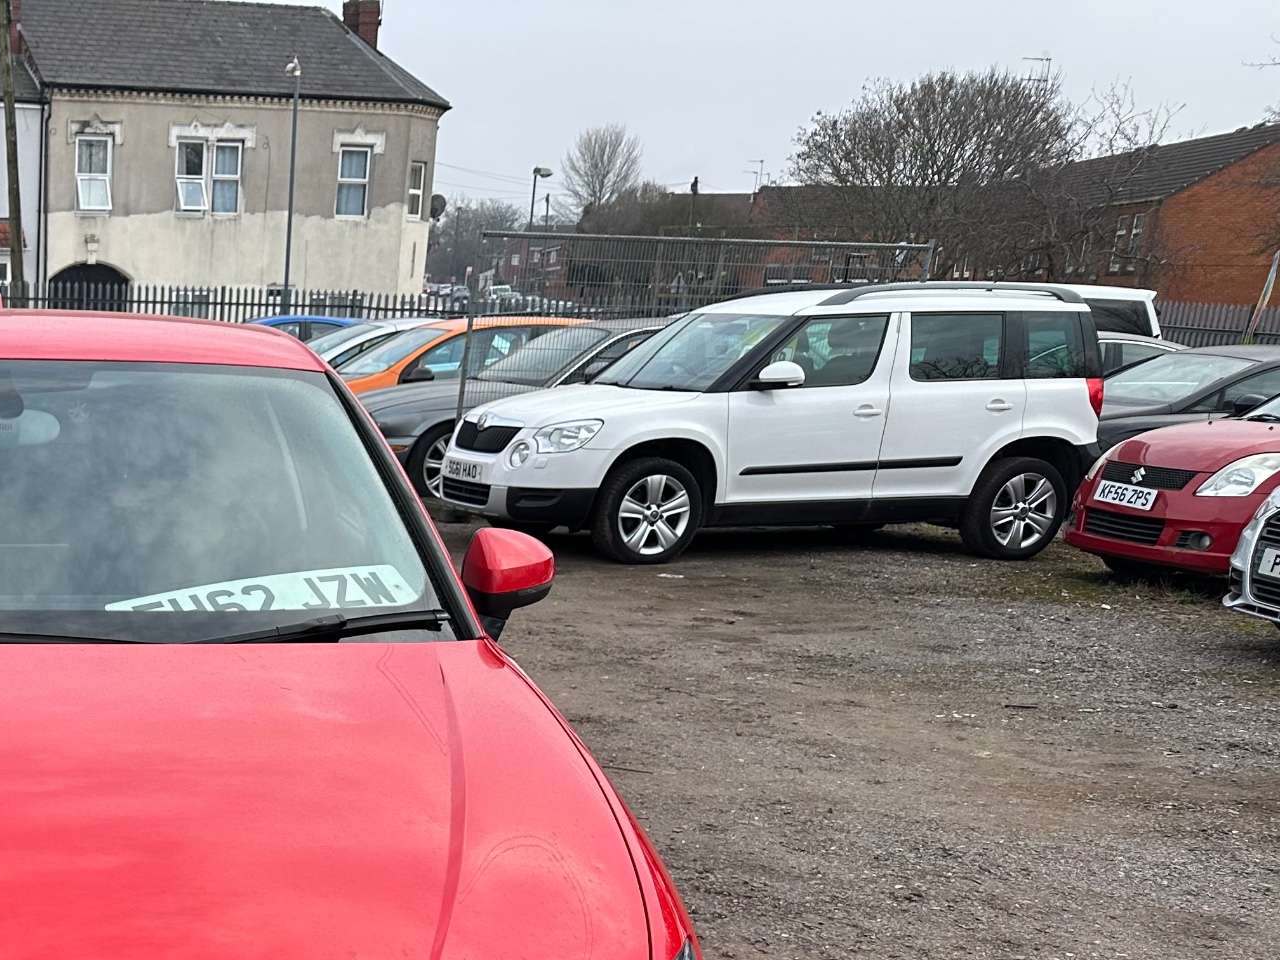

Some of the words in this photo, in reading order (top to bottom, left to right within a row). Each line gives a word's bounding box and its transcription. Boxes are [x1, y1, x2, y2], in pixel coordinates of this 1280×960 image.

[1099, 483, 1128, 502] KF56
[1127, 489, 1151, 507] ZPS
[301, 571, 398, 609] JZW
